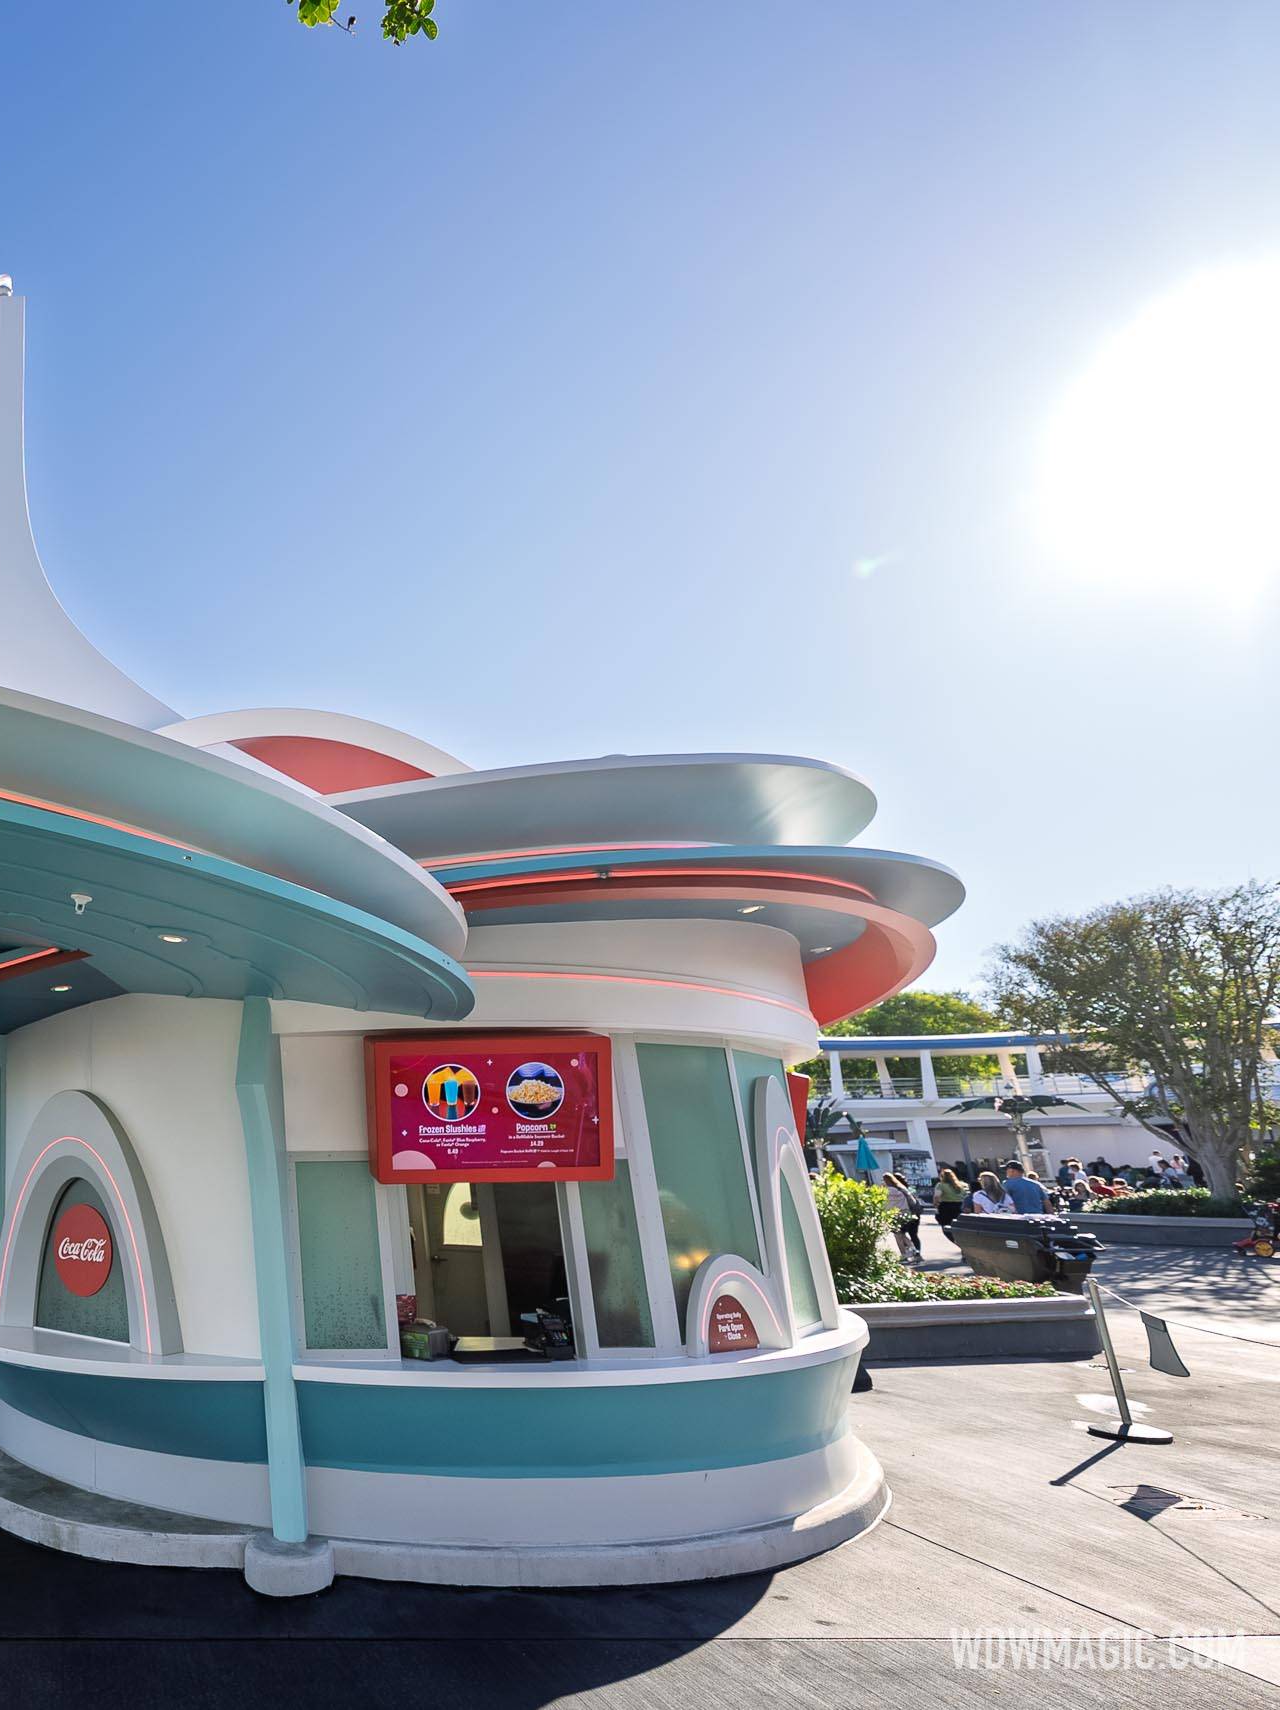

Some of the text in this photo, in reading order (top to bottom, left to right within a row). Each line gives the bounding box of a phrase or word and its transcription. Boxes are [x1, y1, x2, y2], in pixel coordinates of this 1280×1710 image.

[418, 1124, 477, 1134] Frozen Slushies
[516, 1123, 548, 1133] Popcorn
